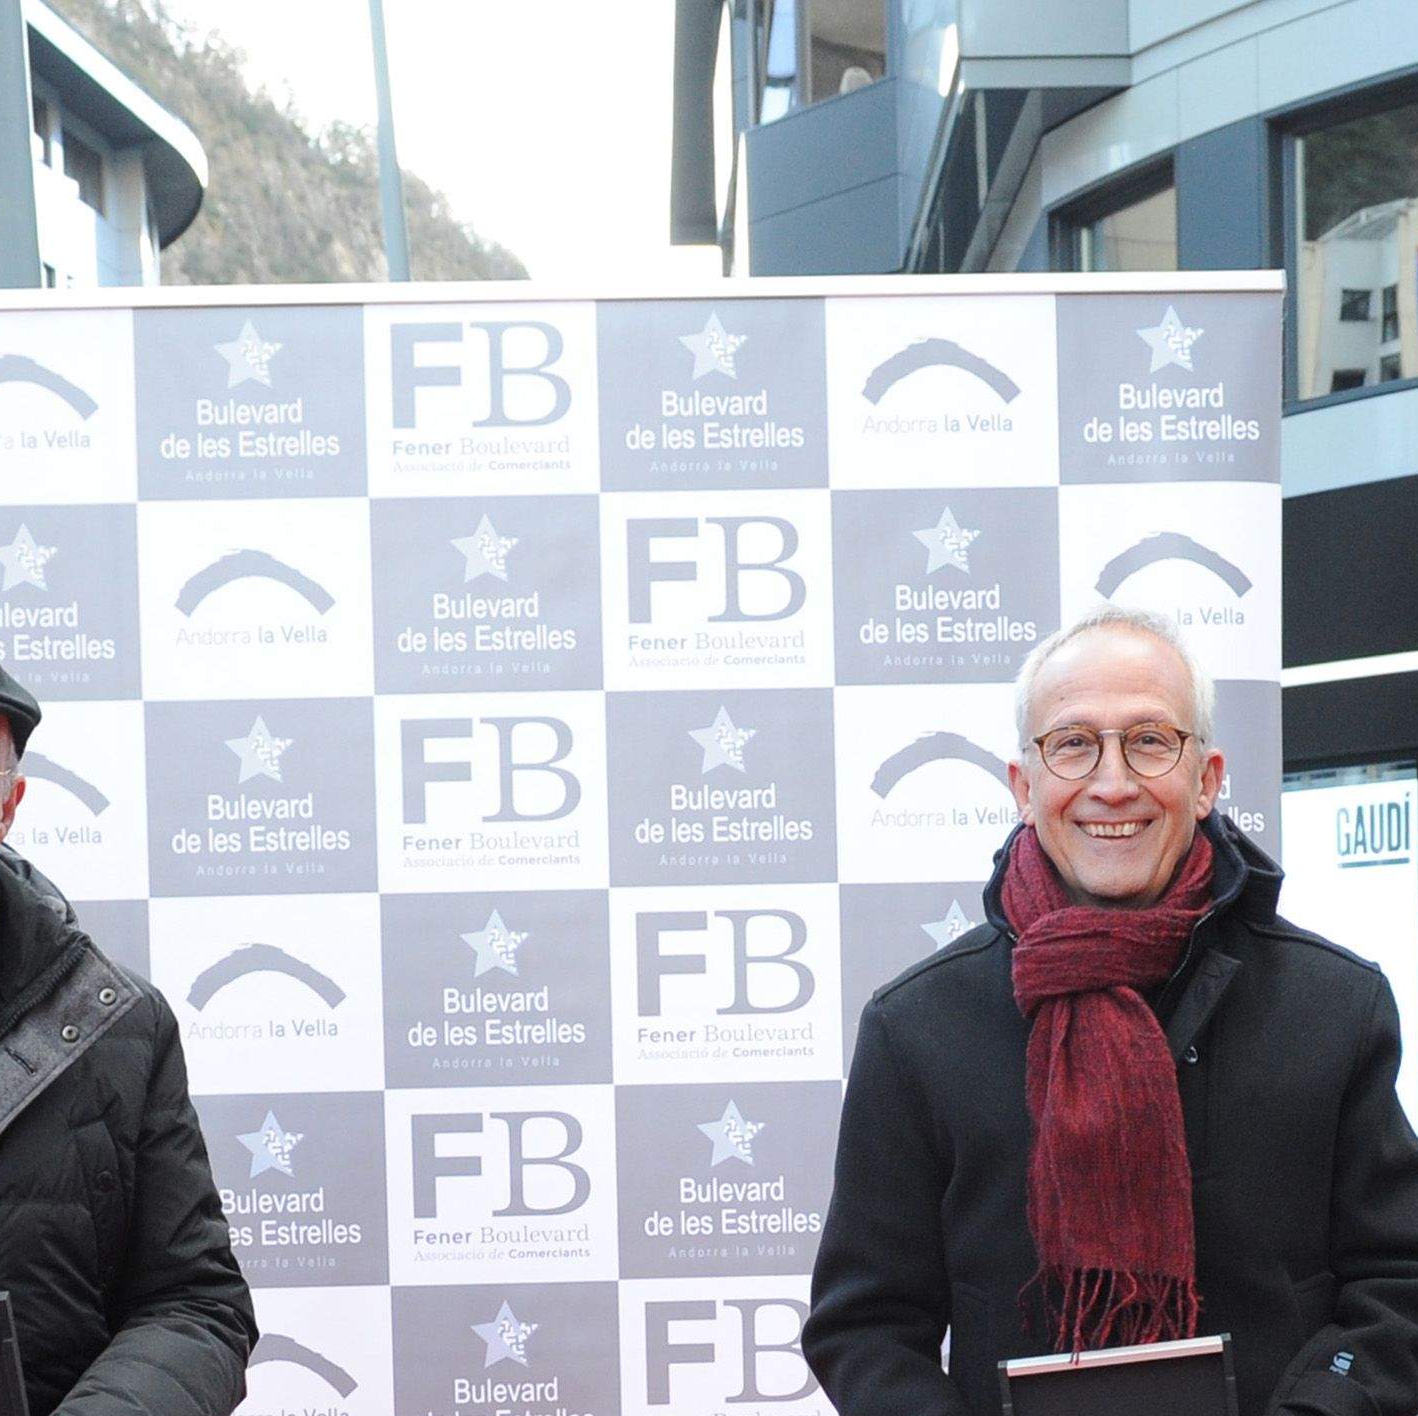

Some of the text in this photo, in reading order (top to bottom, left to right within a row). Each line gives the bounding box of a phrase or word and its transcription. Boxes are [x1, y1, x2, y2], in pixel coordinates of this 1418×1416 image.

[390, 319, 572, 429] FB
[662, 388, 767, 416] Bulevard
[1119, 382, 1224, 409] Bulevard
[197, 397, 303, 425] Bulevard
[626, 420, 804, 450] de les Estrelles
[1083, 414, 1261, 442] de les Estrelles
[161, 430, 341, 459] de les Estrelles
[393, 436, 569, 456] Fener Boulevard
[489, 460, 571, 470] Comerciants
[626, 514, 806, 623] FB
[433, 592, 538, 619] Bulevard
[895, 584, 1000, 610] Bulevard
[397, 624, 576, 652] de les Estrelles
[629, 631, 805, 651] Fener Boulevard
[859, 616, 1037, 643] de les Estrelles
[13, 630, 115, 661] Estrelles
[723, 654, 805, 665] Comerciants
[400, 716, 582, 825] FB
[207, 794, 313, 820] Bulevard
[671, 783, 775, 810] Bulevard
[635, 815, 813, 843] de les Estrelles
[1337, 791, 1410, 856] GAUDÍ
[172, 826, 351, 853] de les Estrelles
[403, 831, 579, 851] Fener Boulevard
[498, 854, 580, 865] Comerciants
[635, 908, 815, 1017] FB
[443, 987, 548, 1013] Bulevard
[408, 1018, 585, 1046] de les Estrelles
[638, 1023, 812, 1043] Fener Boulevard
[732, 1046, 813, 1057] Comerciants
[411, 1109, 591, 1218] FB
[680, 1176, 784, 1203] Bulevard
[228, 1218, 362, 1247] es Estrelles
[414, 1225, 588, 1245] Fener Boulevard
[645, 1208, 821, 1236] de les Estrelles
[508, 1248, 590, 1259] Comerciants
[645, 1298, 819, 1405] FB
[455, 1376, 558, 1402] Bulevard
